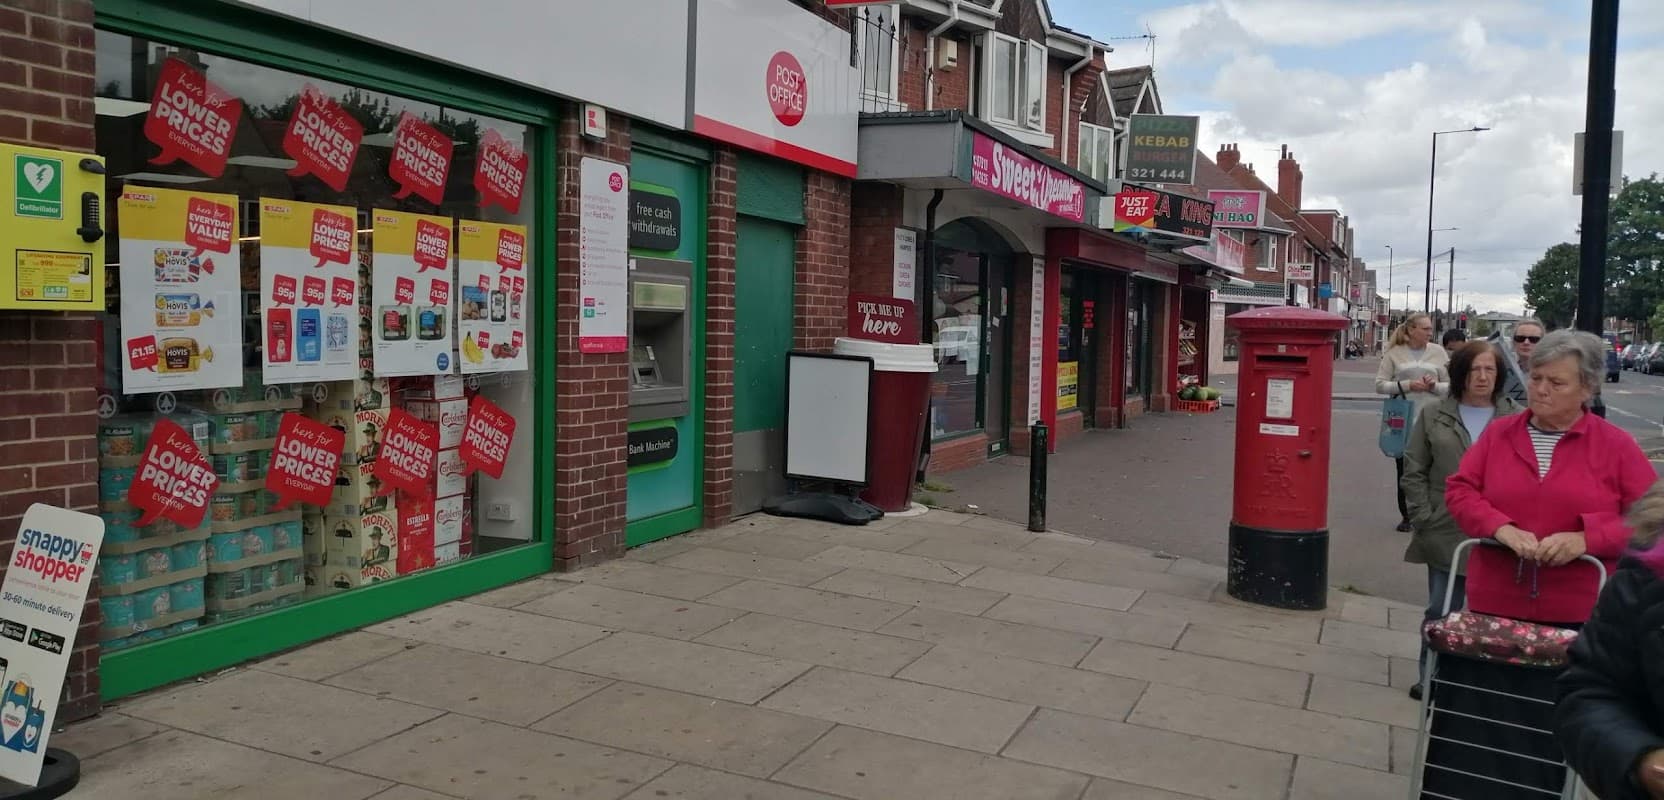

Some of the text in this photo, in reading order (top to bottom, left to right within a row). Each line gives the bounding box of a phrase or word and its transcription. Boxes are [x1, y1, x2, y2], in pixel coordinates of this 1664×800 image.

[777, 65, 801, 90] POST
[177, 72, 226, 109] here for
[770, 84, 803, 111] OFFICE
[160, 82, 231, 138] LOWER
[298, 104, 354, 158] LOWER
[333, 116, 352, 132] for
[168, 131, 205, 156] EVERYDAY
[409, 120, 443, 150] here for
[1135, 136, 1189, 148] KEBAB
[399, 131, 447, 172] LOWER
[1134, 151, 1186, 161] BURGER
[483, 146, 523, 184] LOWER
[991, 142, 1038, 202] Sweet
[1131, 168, 1185, 180] 321 444
[19, 203, 59, 217] Defibrillator
[636, 202, 672, 221] free cash
[1121, 196, 1149, 209] JUST
[1126, 206, 1148, 217] EAT
[1180, 199, 1212, 226] KING
[189, 213, 231, 231] EVERYDAY
[1213, 212, 1255, 223] NI HAO
[189, 222, 231, 242] VALUE
[314, 222, 351, 242] LOWER
[631, 218, 678, 238] withdrawals
[417, 231, 447, 251] LOWER
[499, 239, 523, 255] LOWER
[165, 257, 187, 266] HOVIS
[278, 286, 295, 301] 95p
[307, 287, 324, 301] 95p
[398, 288, 414, 300] 95p
[166, 301, 189, 311] HOVIS
[858, 302, 905, 319] PICK ME UP
[863, 312, 902, 336] here
[132, 347, 155, 360] £1.15
[167, 348, 188, 356] HOVIS
[397, 417, 431, 442] here for
[470, 414, 509, 449] LOWER
[495, 415, 508, 429] for
[166, 431, 192, 453] here
[292, 421, 333, 447] here for
[279, 435, 337, 470] LOWER
[385, 428, 433, 464] LOWER
[629, 442, 644, 455] Bank
[147, 443, 217, 490] LOWER
[284, 477, 316, 492] EVERYDAY
[406, 513, 430, 525] ESTRELLA
[436, 508, 463, 525] Carlsberg
[362, 515, 398, 549] MORETTI
[21, 528, 85, 563] snappy
[14, 546, 85, 583] shopper
[3, 591, 76, 622] 30-60 minute delivery
